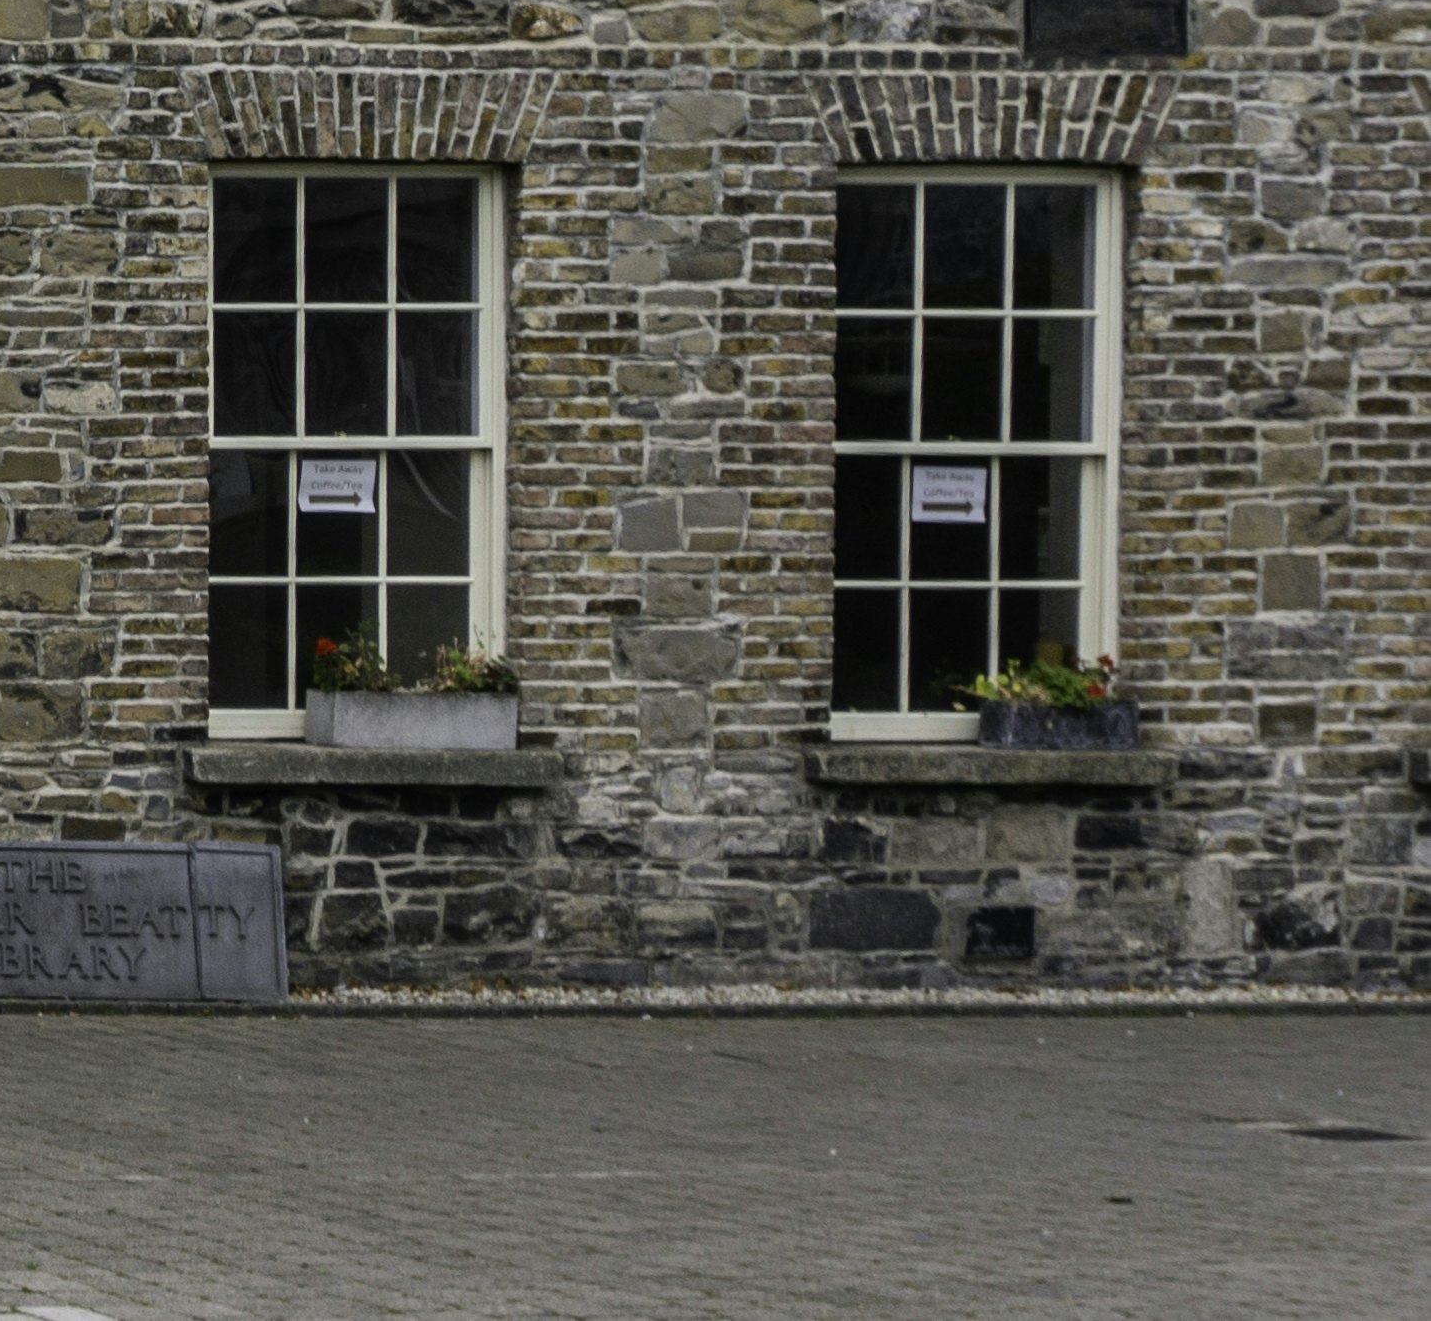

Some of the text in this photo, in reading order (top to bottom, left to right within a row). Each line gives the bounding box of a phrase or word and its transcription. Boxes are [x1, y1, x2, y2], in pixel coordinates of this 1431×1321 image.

[314, 464, 364, 475] Take Away
[311, 480, 363, 490] Coffee/Tea
[79, 903, 257, 940] BEATTY
